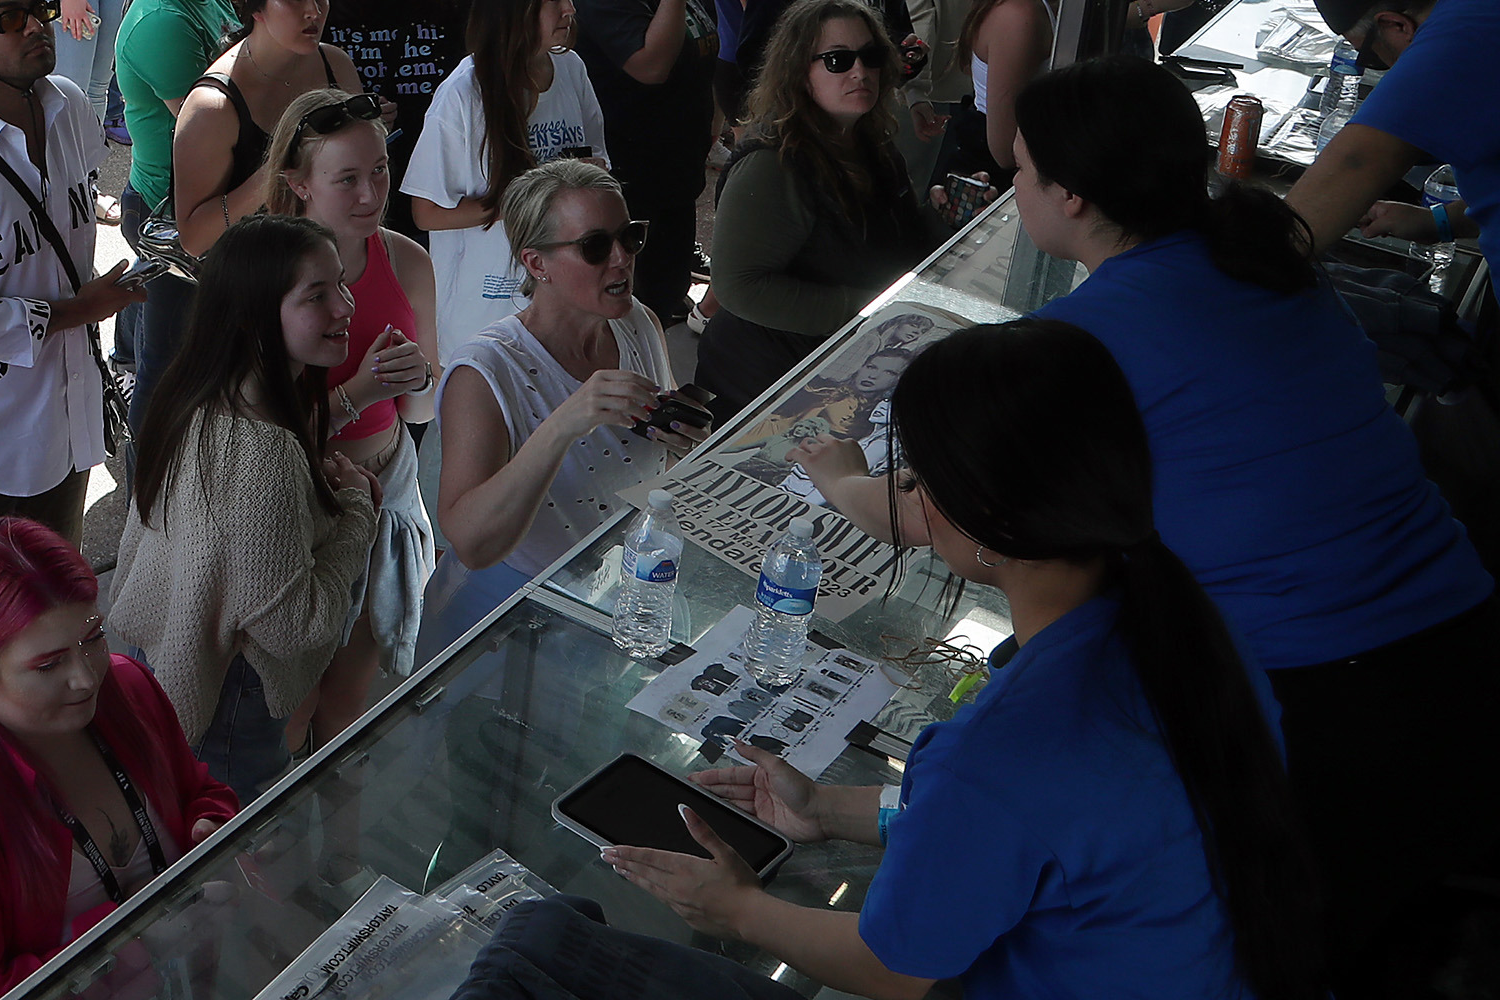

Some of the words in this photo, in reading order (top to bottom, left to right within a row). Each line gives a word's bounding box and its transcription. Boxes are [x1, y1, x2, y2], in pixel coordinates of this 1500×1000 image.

[330, 26, 364, 43] it's
[347, 45, 382, 60] i'm
[400, 42, 432, 59] he
[396, 81, 433, 94] me
[550, 125, 584, 146] SAYS
[661, 478, 719, 514] THE
[821, 558, 878, 596] OUR
[680, 459, 810, 533] TAYLOR
[812, 512, 918, 578] SWIFT
[671, 499, 703, 520] arch
[819, 578, 852, 598] 023
[321, 904, 399, 974] TAYLORSWIFT.COM
